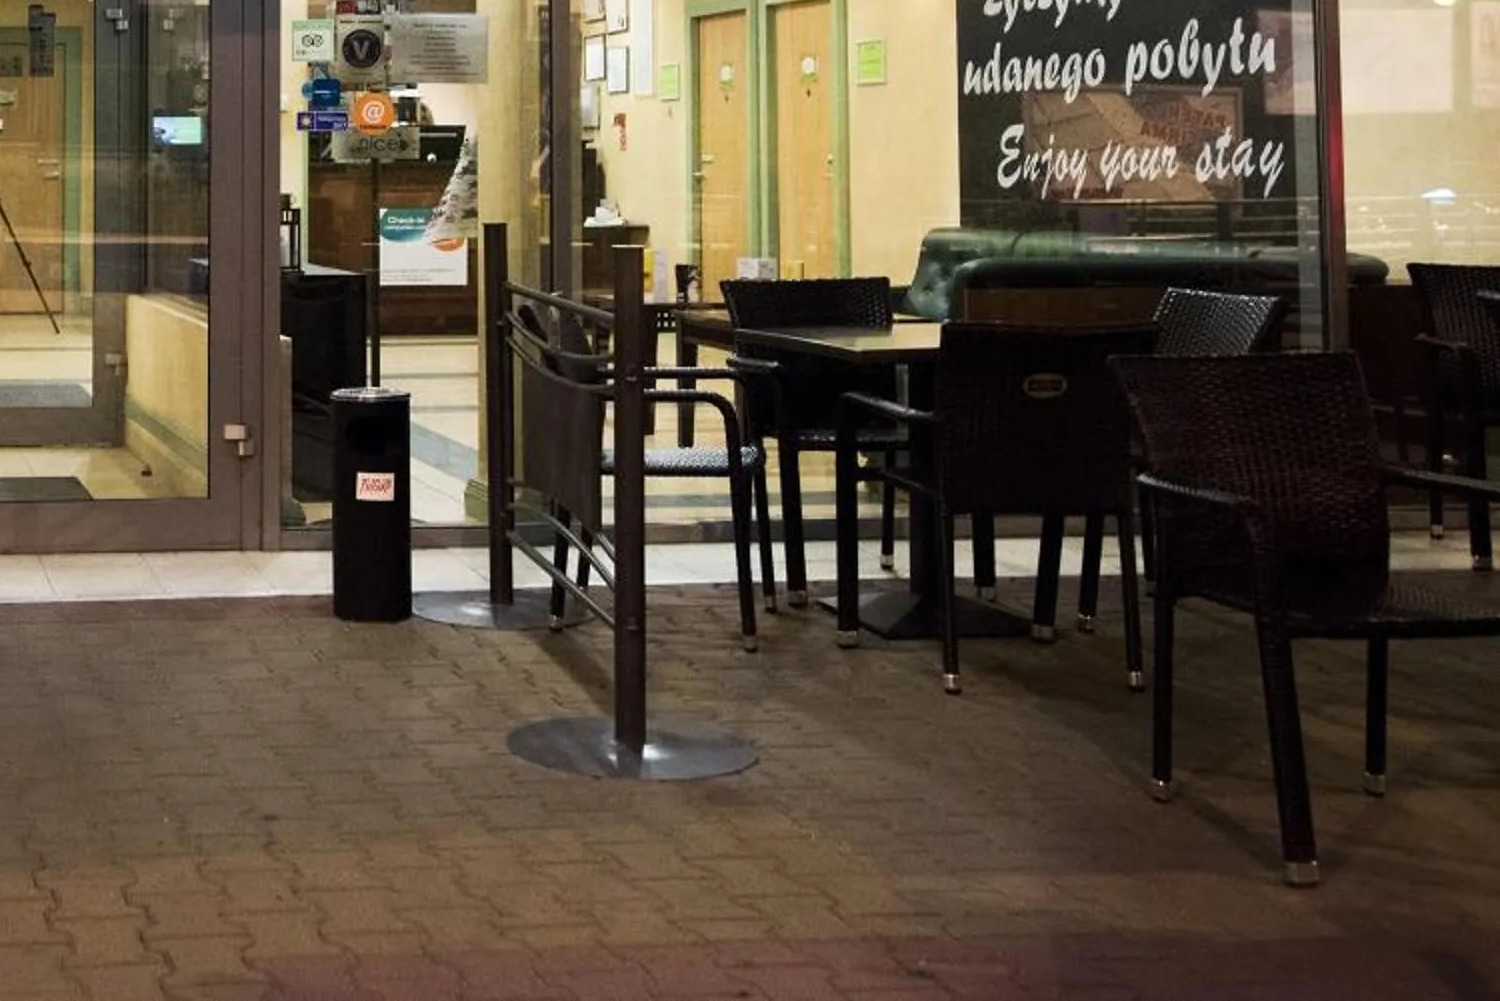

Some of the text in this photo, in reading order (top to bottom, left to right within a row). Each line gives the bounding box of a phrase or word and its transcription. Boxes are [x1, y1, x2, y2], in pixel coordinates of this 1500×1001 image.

[963, 17, 1276, 104] udanego pobytu
[997, 124, 1284, 199] Enjoy your stay
